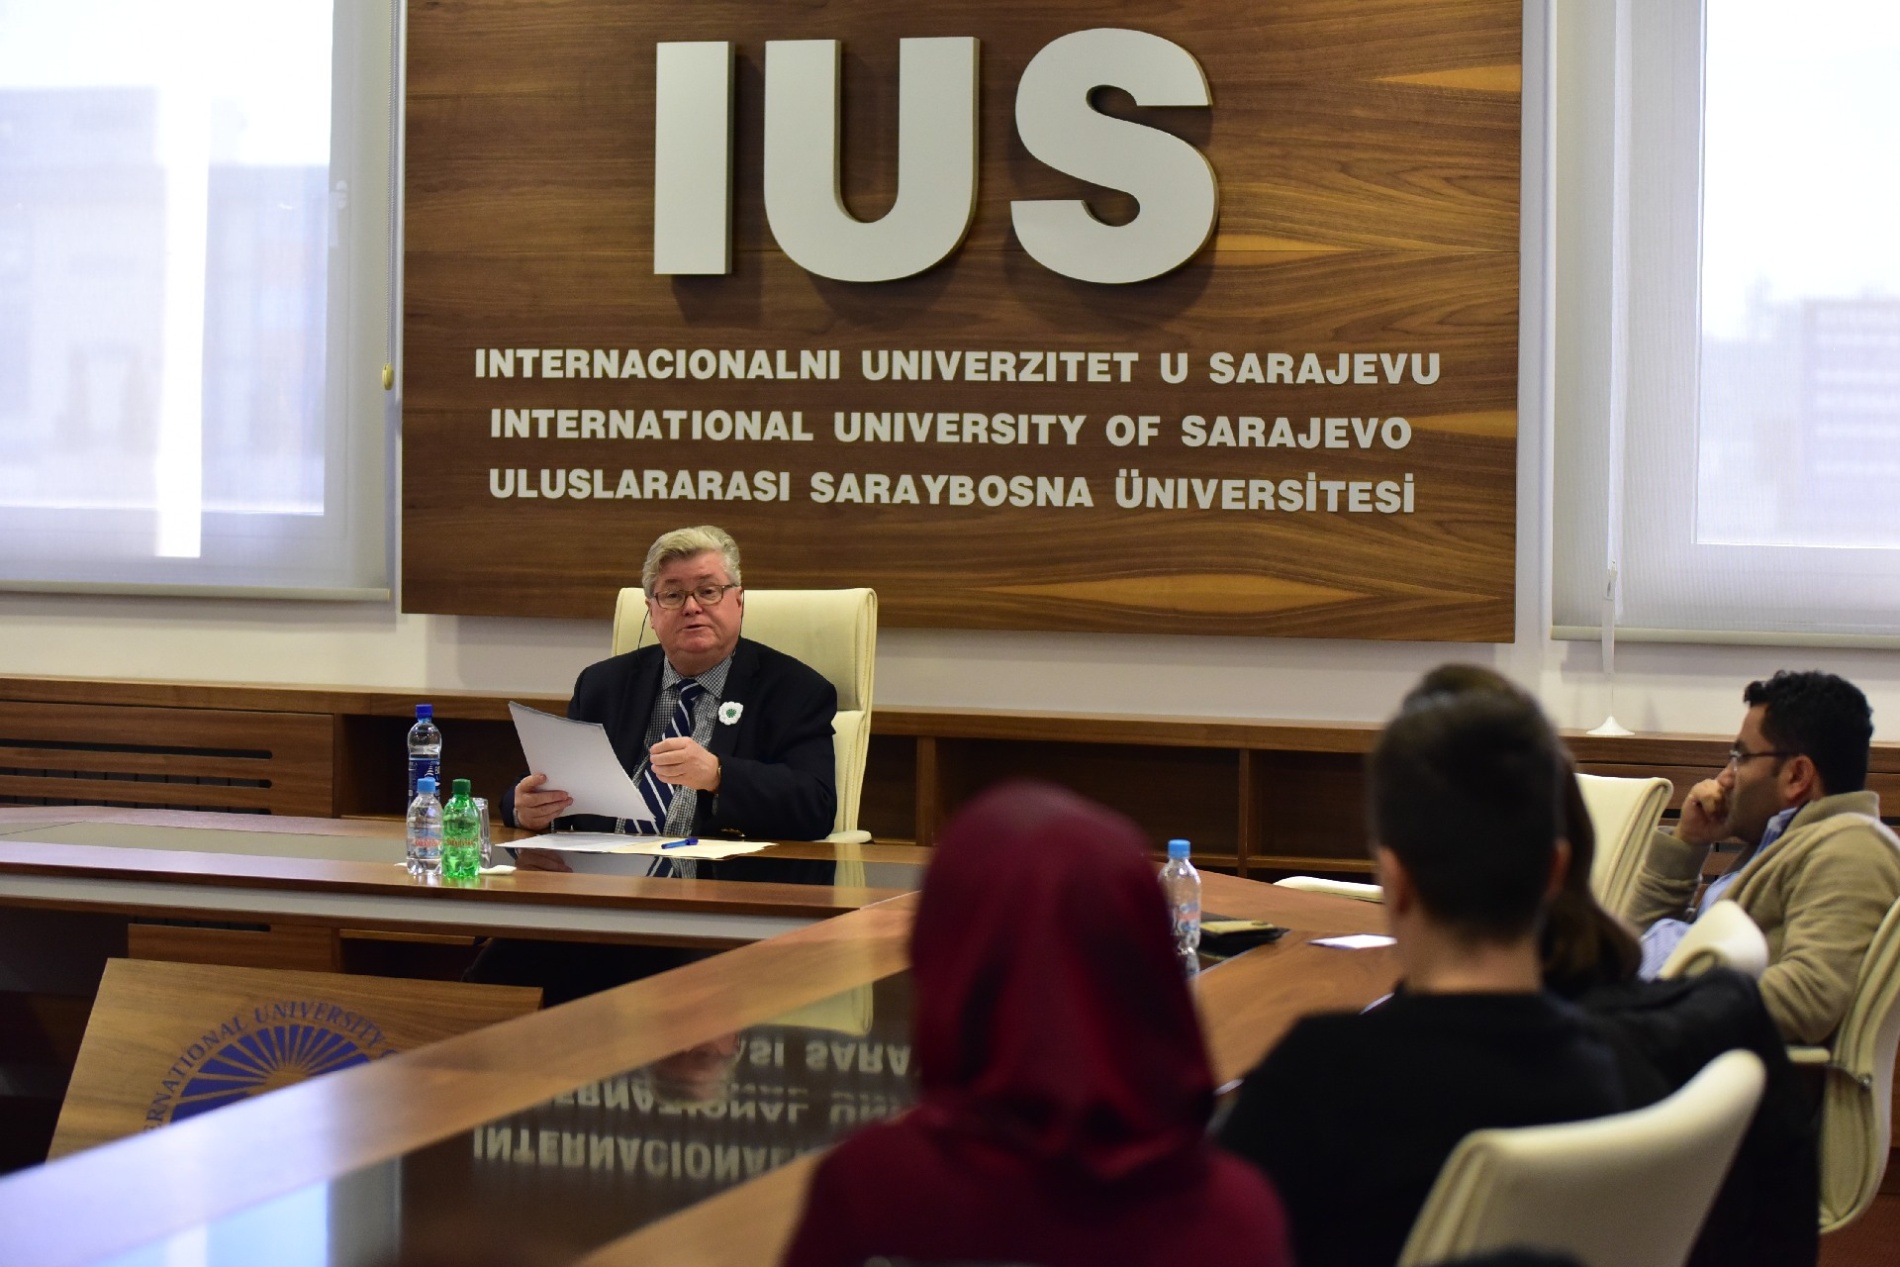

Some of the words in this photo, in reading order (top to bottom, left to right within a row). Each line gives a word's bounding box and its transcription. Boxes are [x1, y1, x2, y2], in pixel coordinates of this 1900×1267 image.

[653, 27, 1219, 284] IUS
[475, 348, 841, 380] INTERNACIONALNI
[862, 350, 1139, 382] UNIVERZITET
[1160, 352, 1188, 384] U
[1209, 351, 1441, 385] SARAJEVU
[490, 408, 814, 441] INTERNATIONAL
[834, 412, 1088, 445] UNIVERSITY
[1105, 414, 1162, 446] OF
[1181, 415, 1413, 449] SARAJEVO
[488, 468, 791, 501] ULUSLARARASI
[809, 471, 1094, 507] SARAYBOSNA
[255, 1001, 387, 1047] UNIVERSITY
